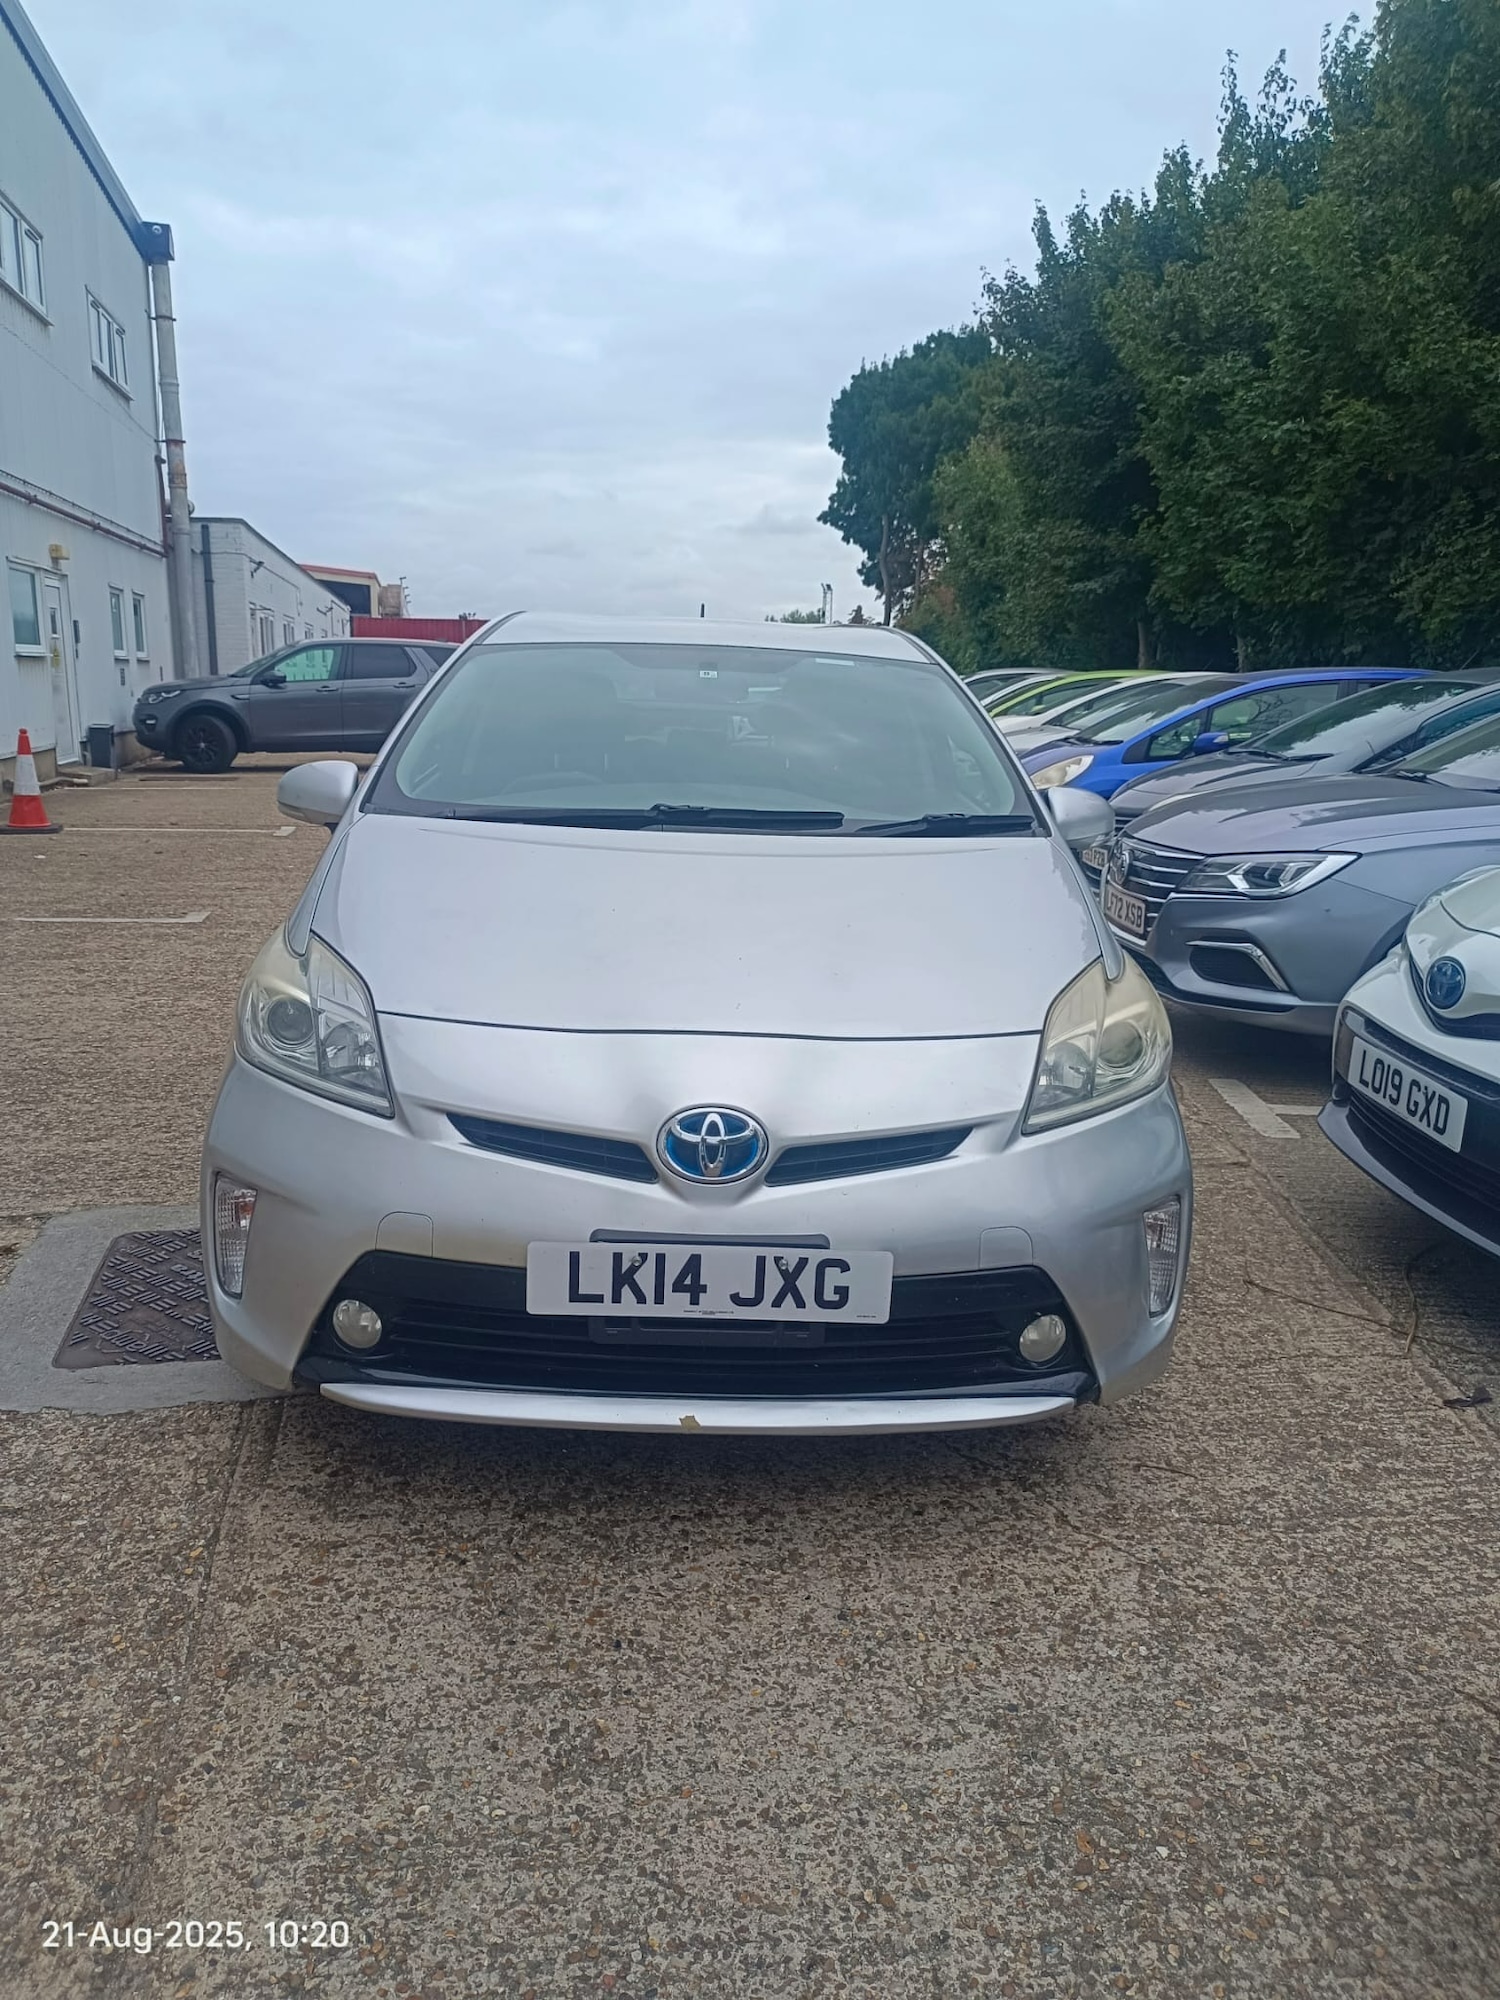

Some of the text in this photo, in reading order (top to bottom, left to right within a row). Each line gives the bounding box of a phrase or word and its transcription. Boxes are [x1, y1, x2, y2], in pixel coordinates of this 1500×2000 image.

[1125, 900, 1143, 928] XSB
[1359, 1049, 1450, 1135] LO19 GXD
[568, 1251, 851, 1309] LK14 JXG
